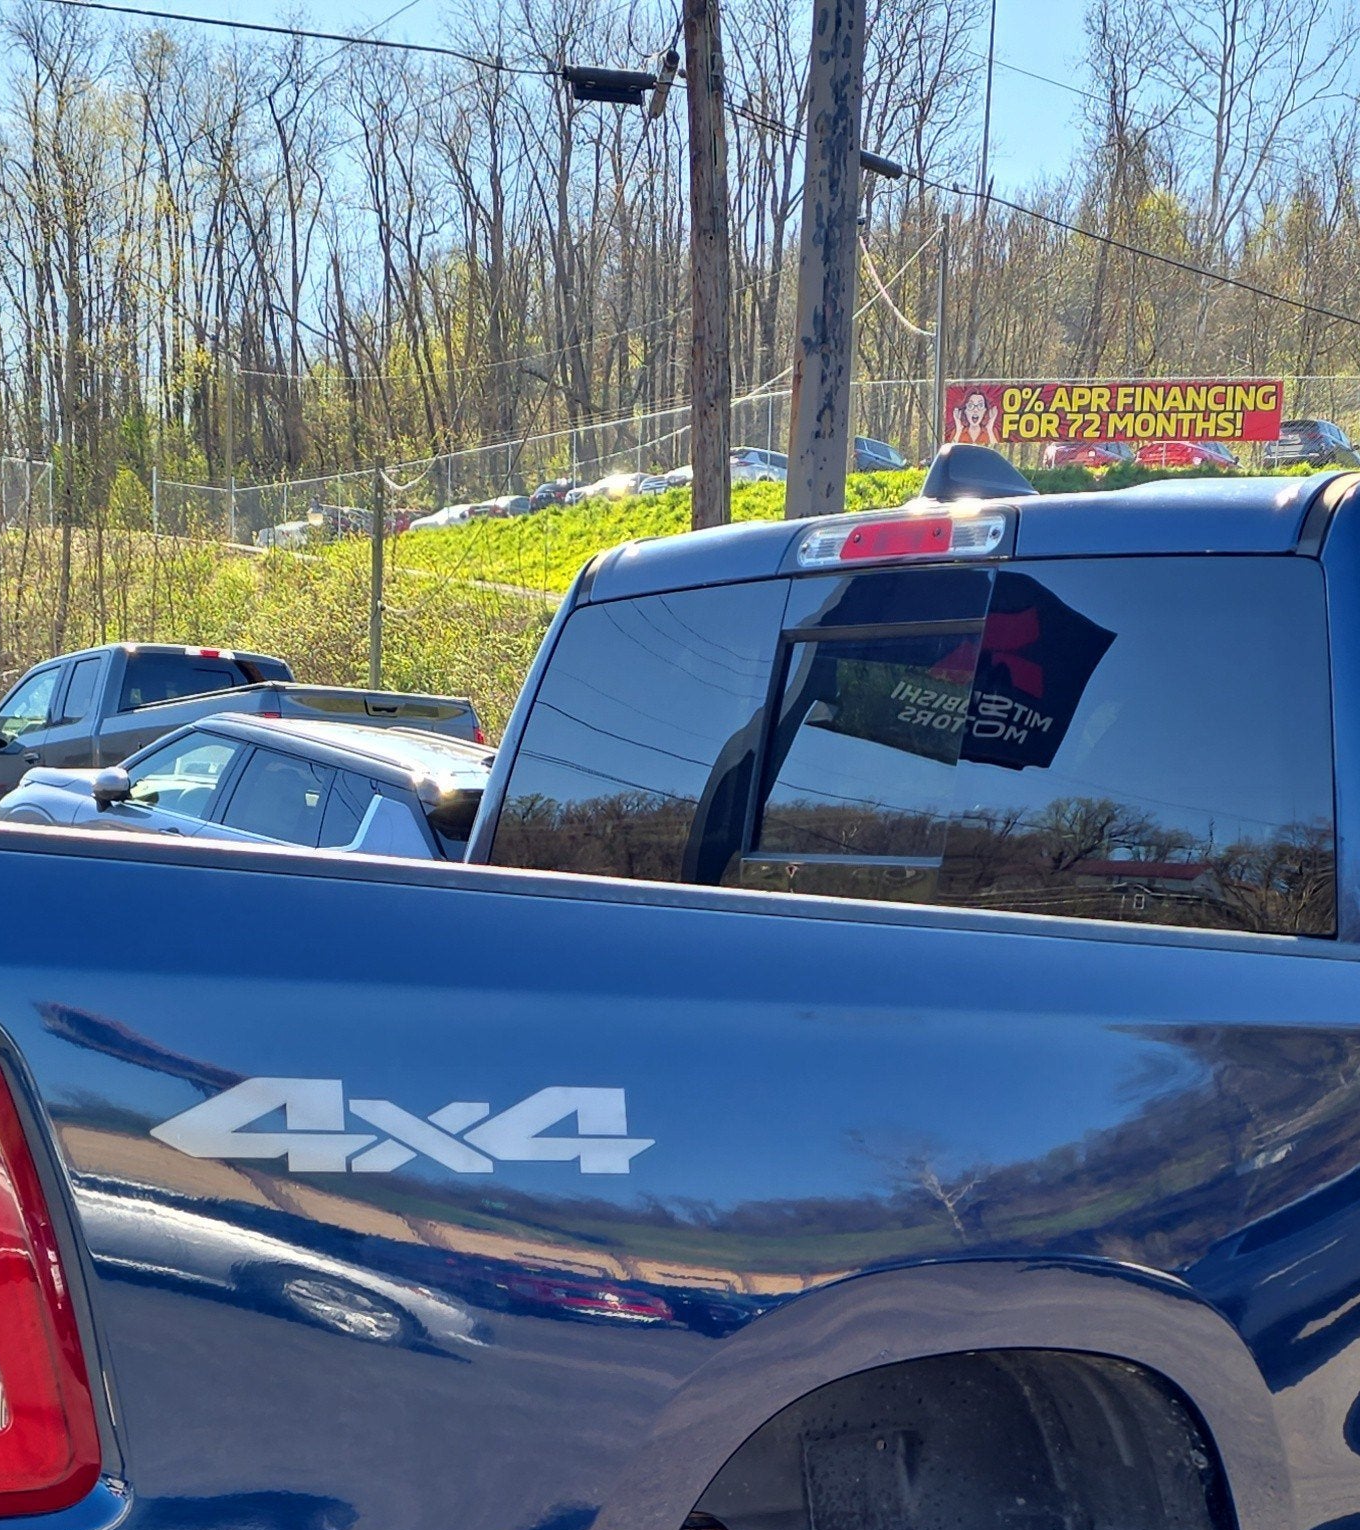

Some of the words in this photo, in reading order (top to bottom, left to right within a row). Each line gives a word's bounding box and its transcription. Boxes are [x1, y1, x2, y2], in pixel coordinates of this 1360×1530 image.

[1001, 387, 1044, 414] 0%
[1049, 386, 1110, 412] APR
[1117, 385, 1276, 412] FINANCING
[1001, 413, 1058, 439] FOR
[1067, 412, 1100, 438] 72
[1107, 412, 1244, 439] MONTHS!
